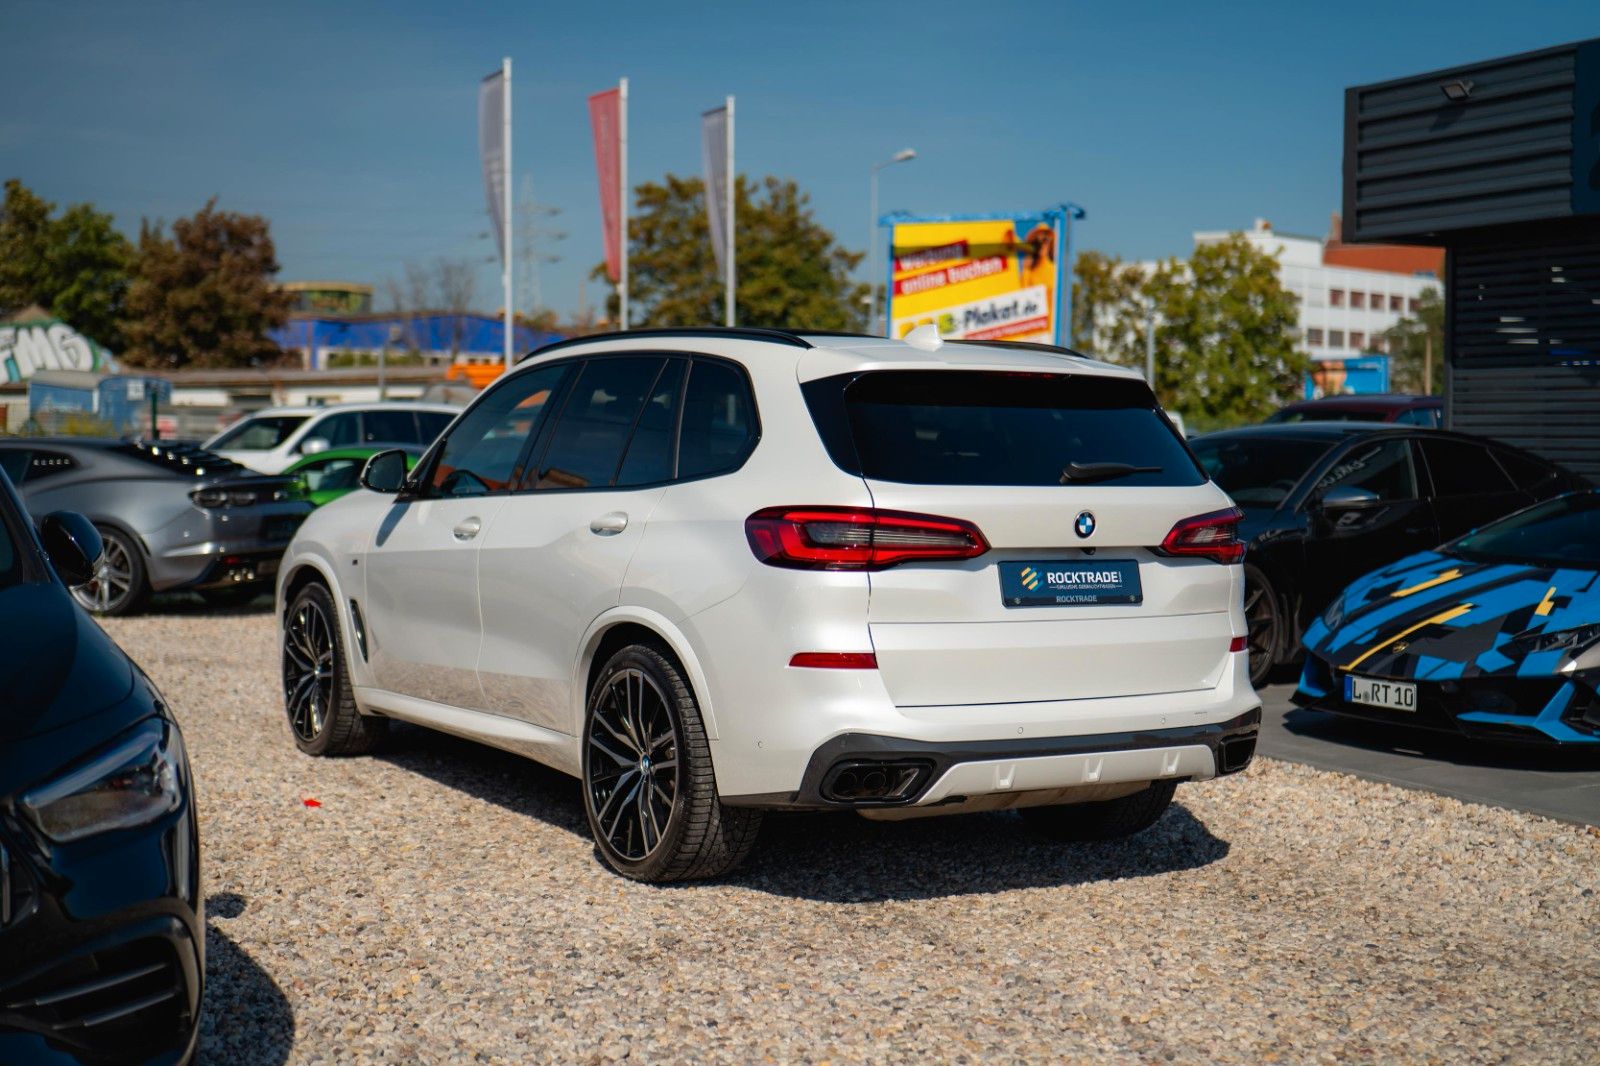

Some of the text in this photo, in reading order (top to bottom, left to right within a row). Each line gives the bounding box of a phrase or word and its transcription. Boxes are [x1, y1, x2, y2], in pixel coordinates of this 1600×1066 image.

[1047, 571, 1119, 584] ROCKTRADE
[1056, 594, 1098, 603] ROCKTRADE
[1353, 680, 1414, 707] L RT 10
